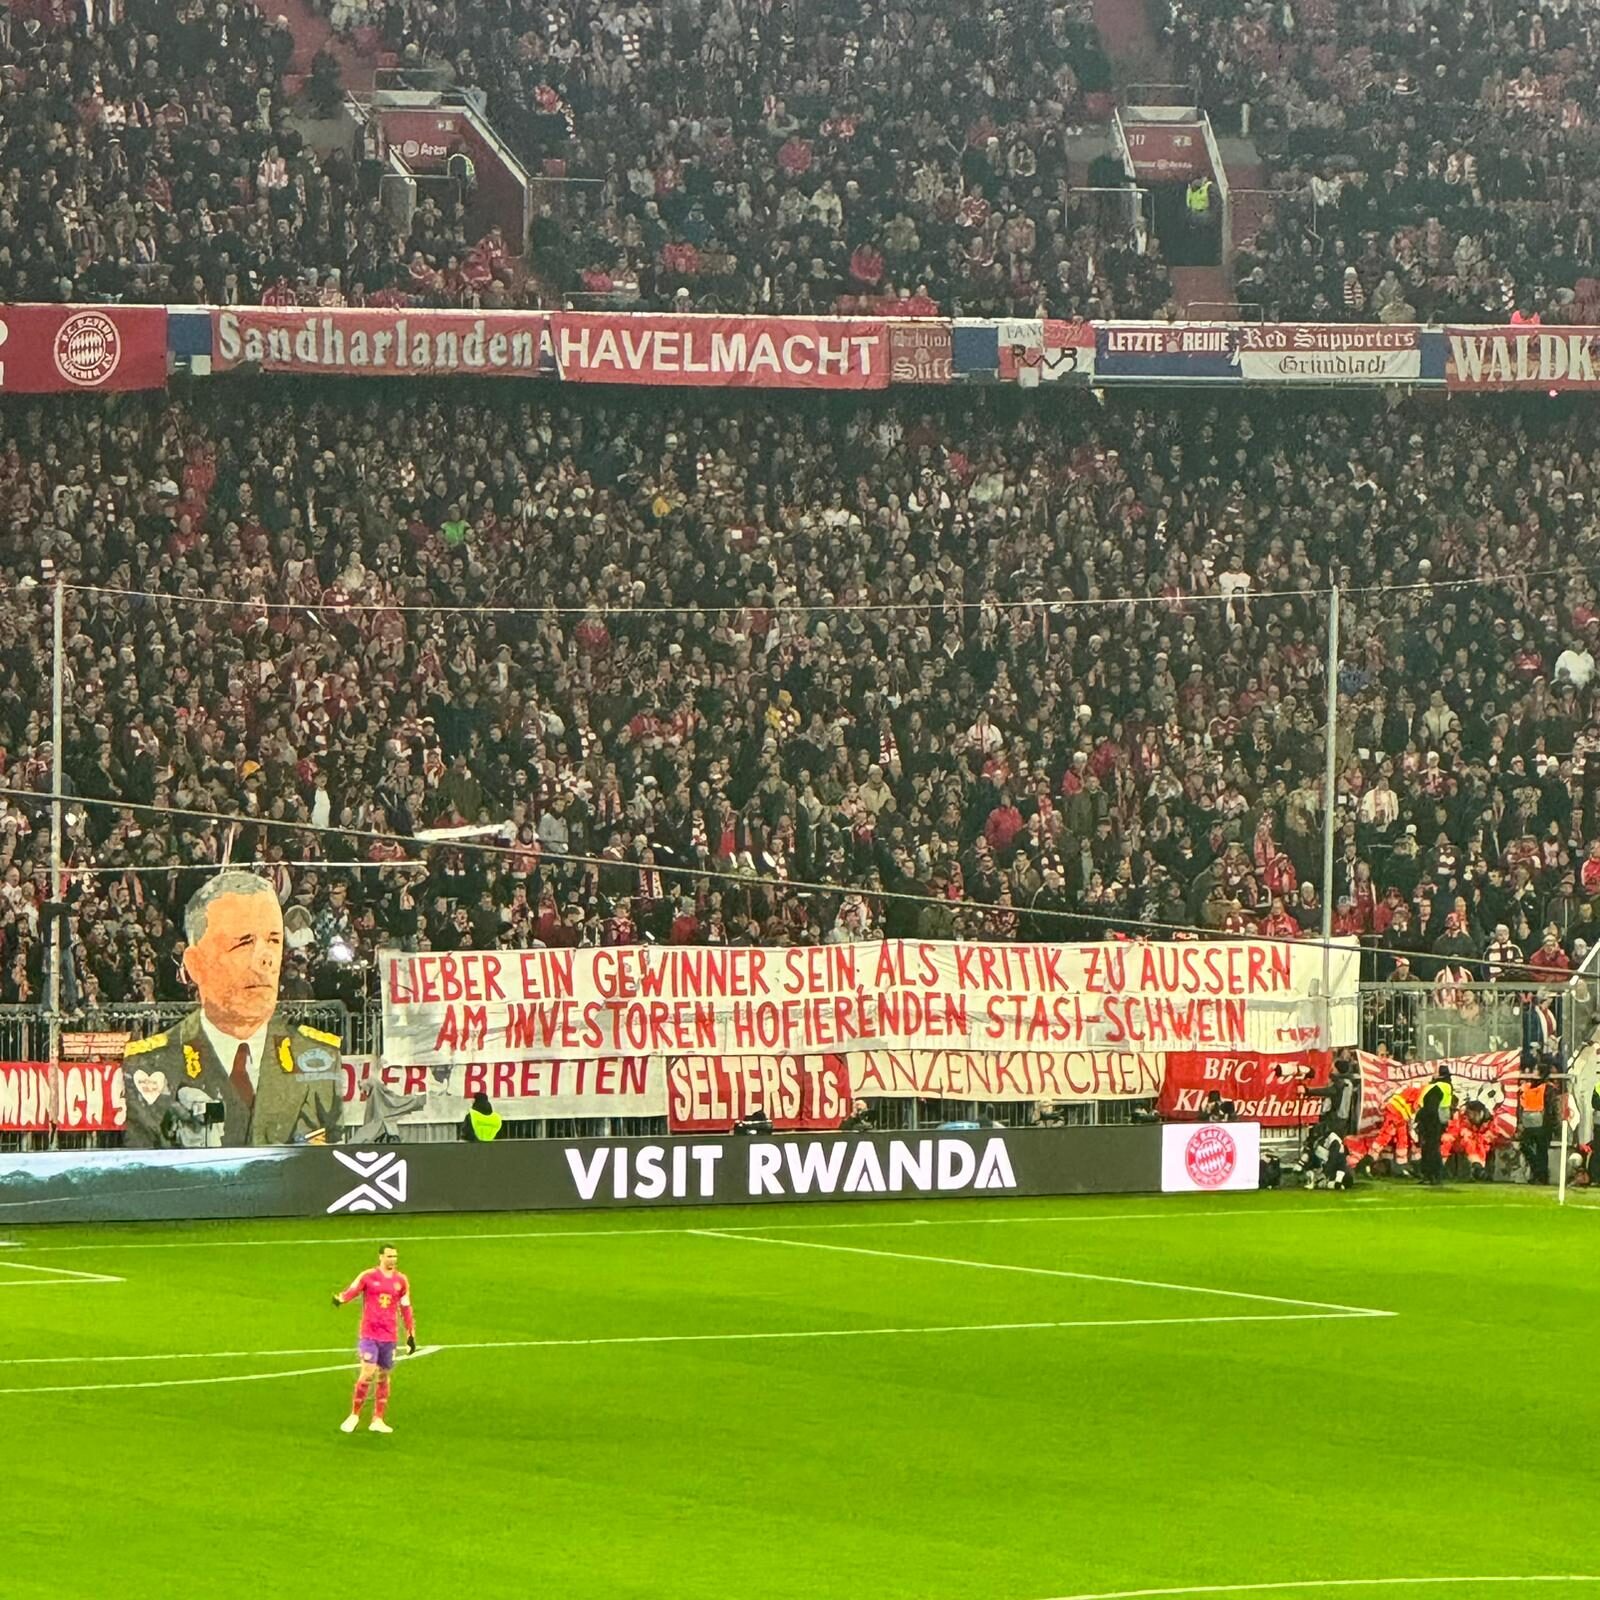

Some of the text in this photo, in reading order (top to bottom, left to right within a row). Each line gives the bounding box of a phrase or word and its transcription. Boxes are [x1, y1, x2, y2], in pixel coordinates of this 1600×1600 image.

[219, 312, 534, 368] Sandharlanden
[560, 327, 879, 377] HAVELMACHT
[1108, 331, 1163, 351] LETZTE
[1242, 327, 1287, 349] Red
[390, 955, 506, 1003] LIEBER
[520, 950, 574, 999] EIN
[593, 946, 770, 998] GEWINNER
[874, 938, 940, 987] ALS
[954, 944, 1069, 992] KRITIK
[1080, 946, 1126, 993] ZU
[434, 988, 1247, 1051] AM INVESTOREN HOFIERENDEN STASI-SCHWEIN
[0, 1065, 127, 1127] MUNICH'S
[464, 1056, 649, 1099] BRETTEN
[670, 1055, 801, 1121] SELTERS
[854, 1049, 1164, 1097] ANZENKIRCHEN
[1203, 1057, 1258, 1084] BFC
[565, 1138, 1017, 1200] VISIT RWANDA
